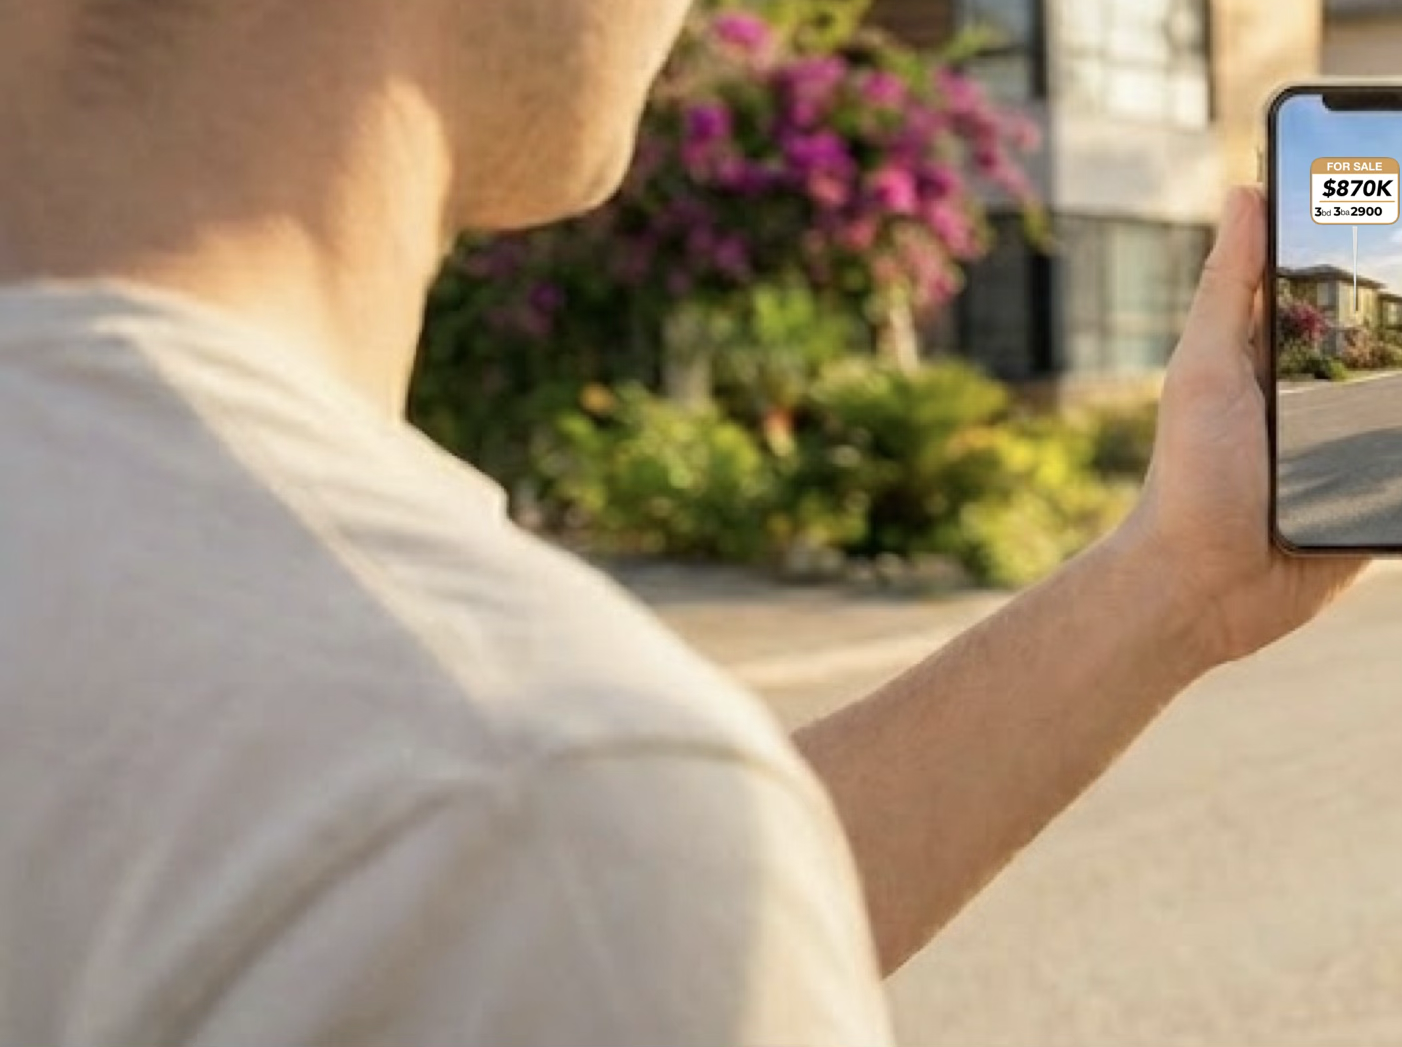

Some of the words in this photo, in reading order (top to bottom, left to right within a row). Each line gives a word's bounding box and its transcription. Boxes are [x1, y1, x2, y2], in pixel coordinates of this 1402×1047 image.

[1327, 162, 1351, 171] FOR
[1353, 162, 1383, 171] SALE
[1322, 178, 1394, 198] $870K
